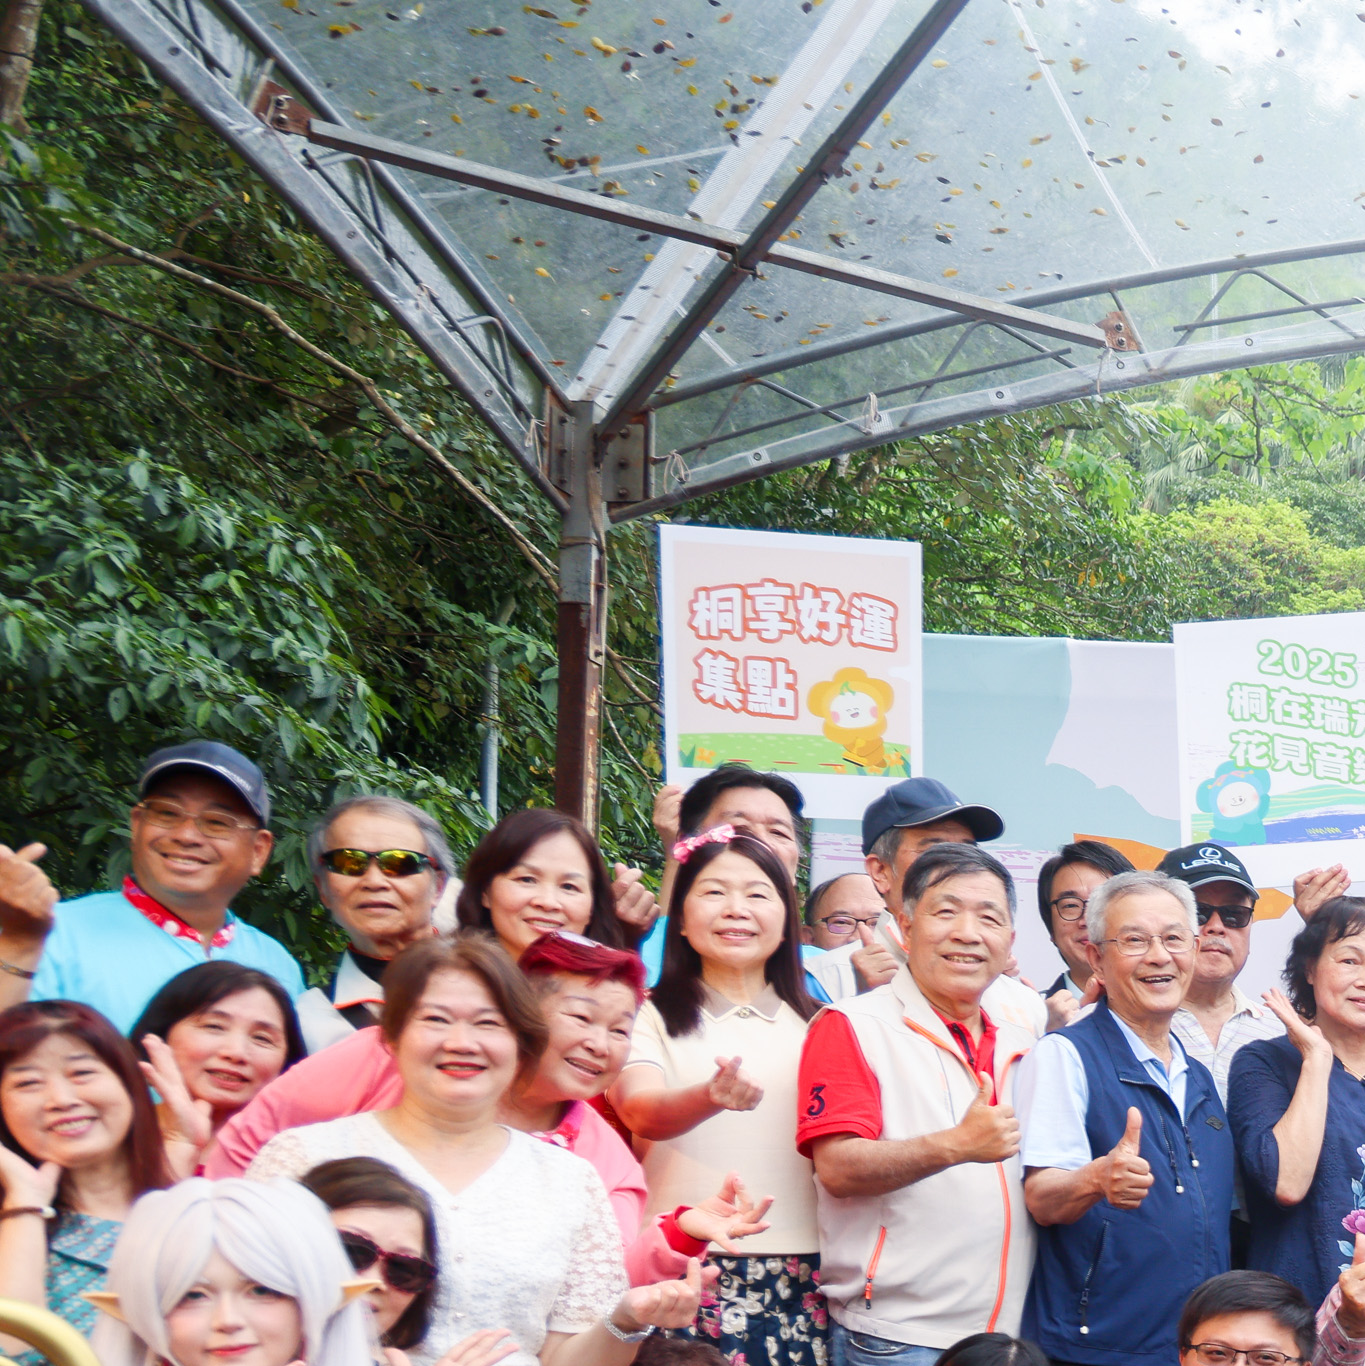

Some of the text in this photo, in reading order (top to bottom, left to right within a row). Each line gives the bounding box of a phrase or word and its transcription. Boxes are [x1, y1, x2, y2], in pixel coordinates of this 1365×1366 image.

[689, 579, 897, 651] 桐享好運
[693, 648, 798, 719] 集點
[1257, 640, 1357, 688] 2025
[1181, 858, 1241, 872] LEXUS
[807, 1085, 826, 1116] 3
